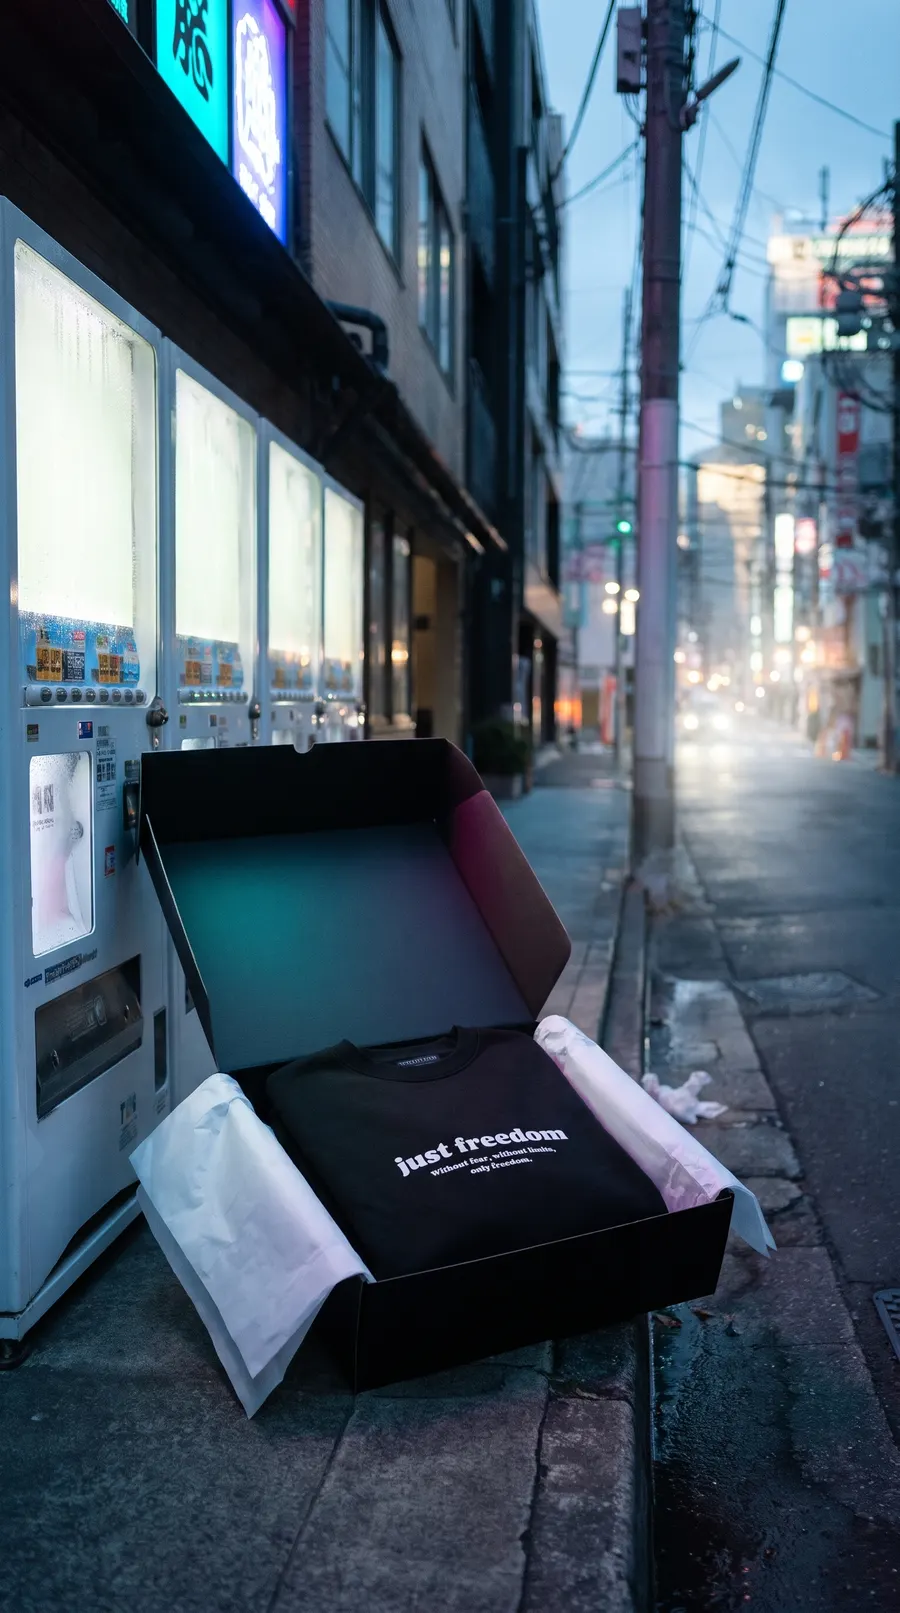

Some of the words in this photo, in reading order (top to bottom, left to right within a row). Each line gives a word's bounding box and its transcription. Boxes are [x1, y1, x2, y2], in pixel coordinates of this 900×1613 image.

[394, 1142, 453, 1177] just
[454, 1128, 568, 1153] freedom
[430, 1159, 469, 1177] Without
[492, 1148, 528, 1159] without
[470, 1164, 491, 1174] only
[491, 1157, 533, 1169] freedom.
